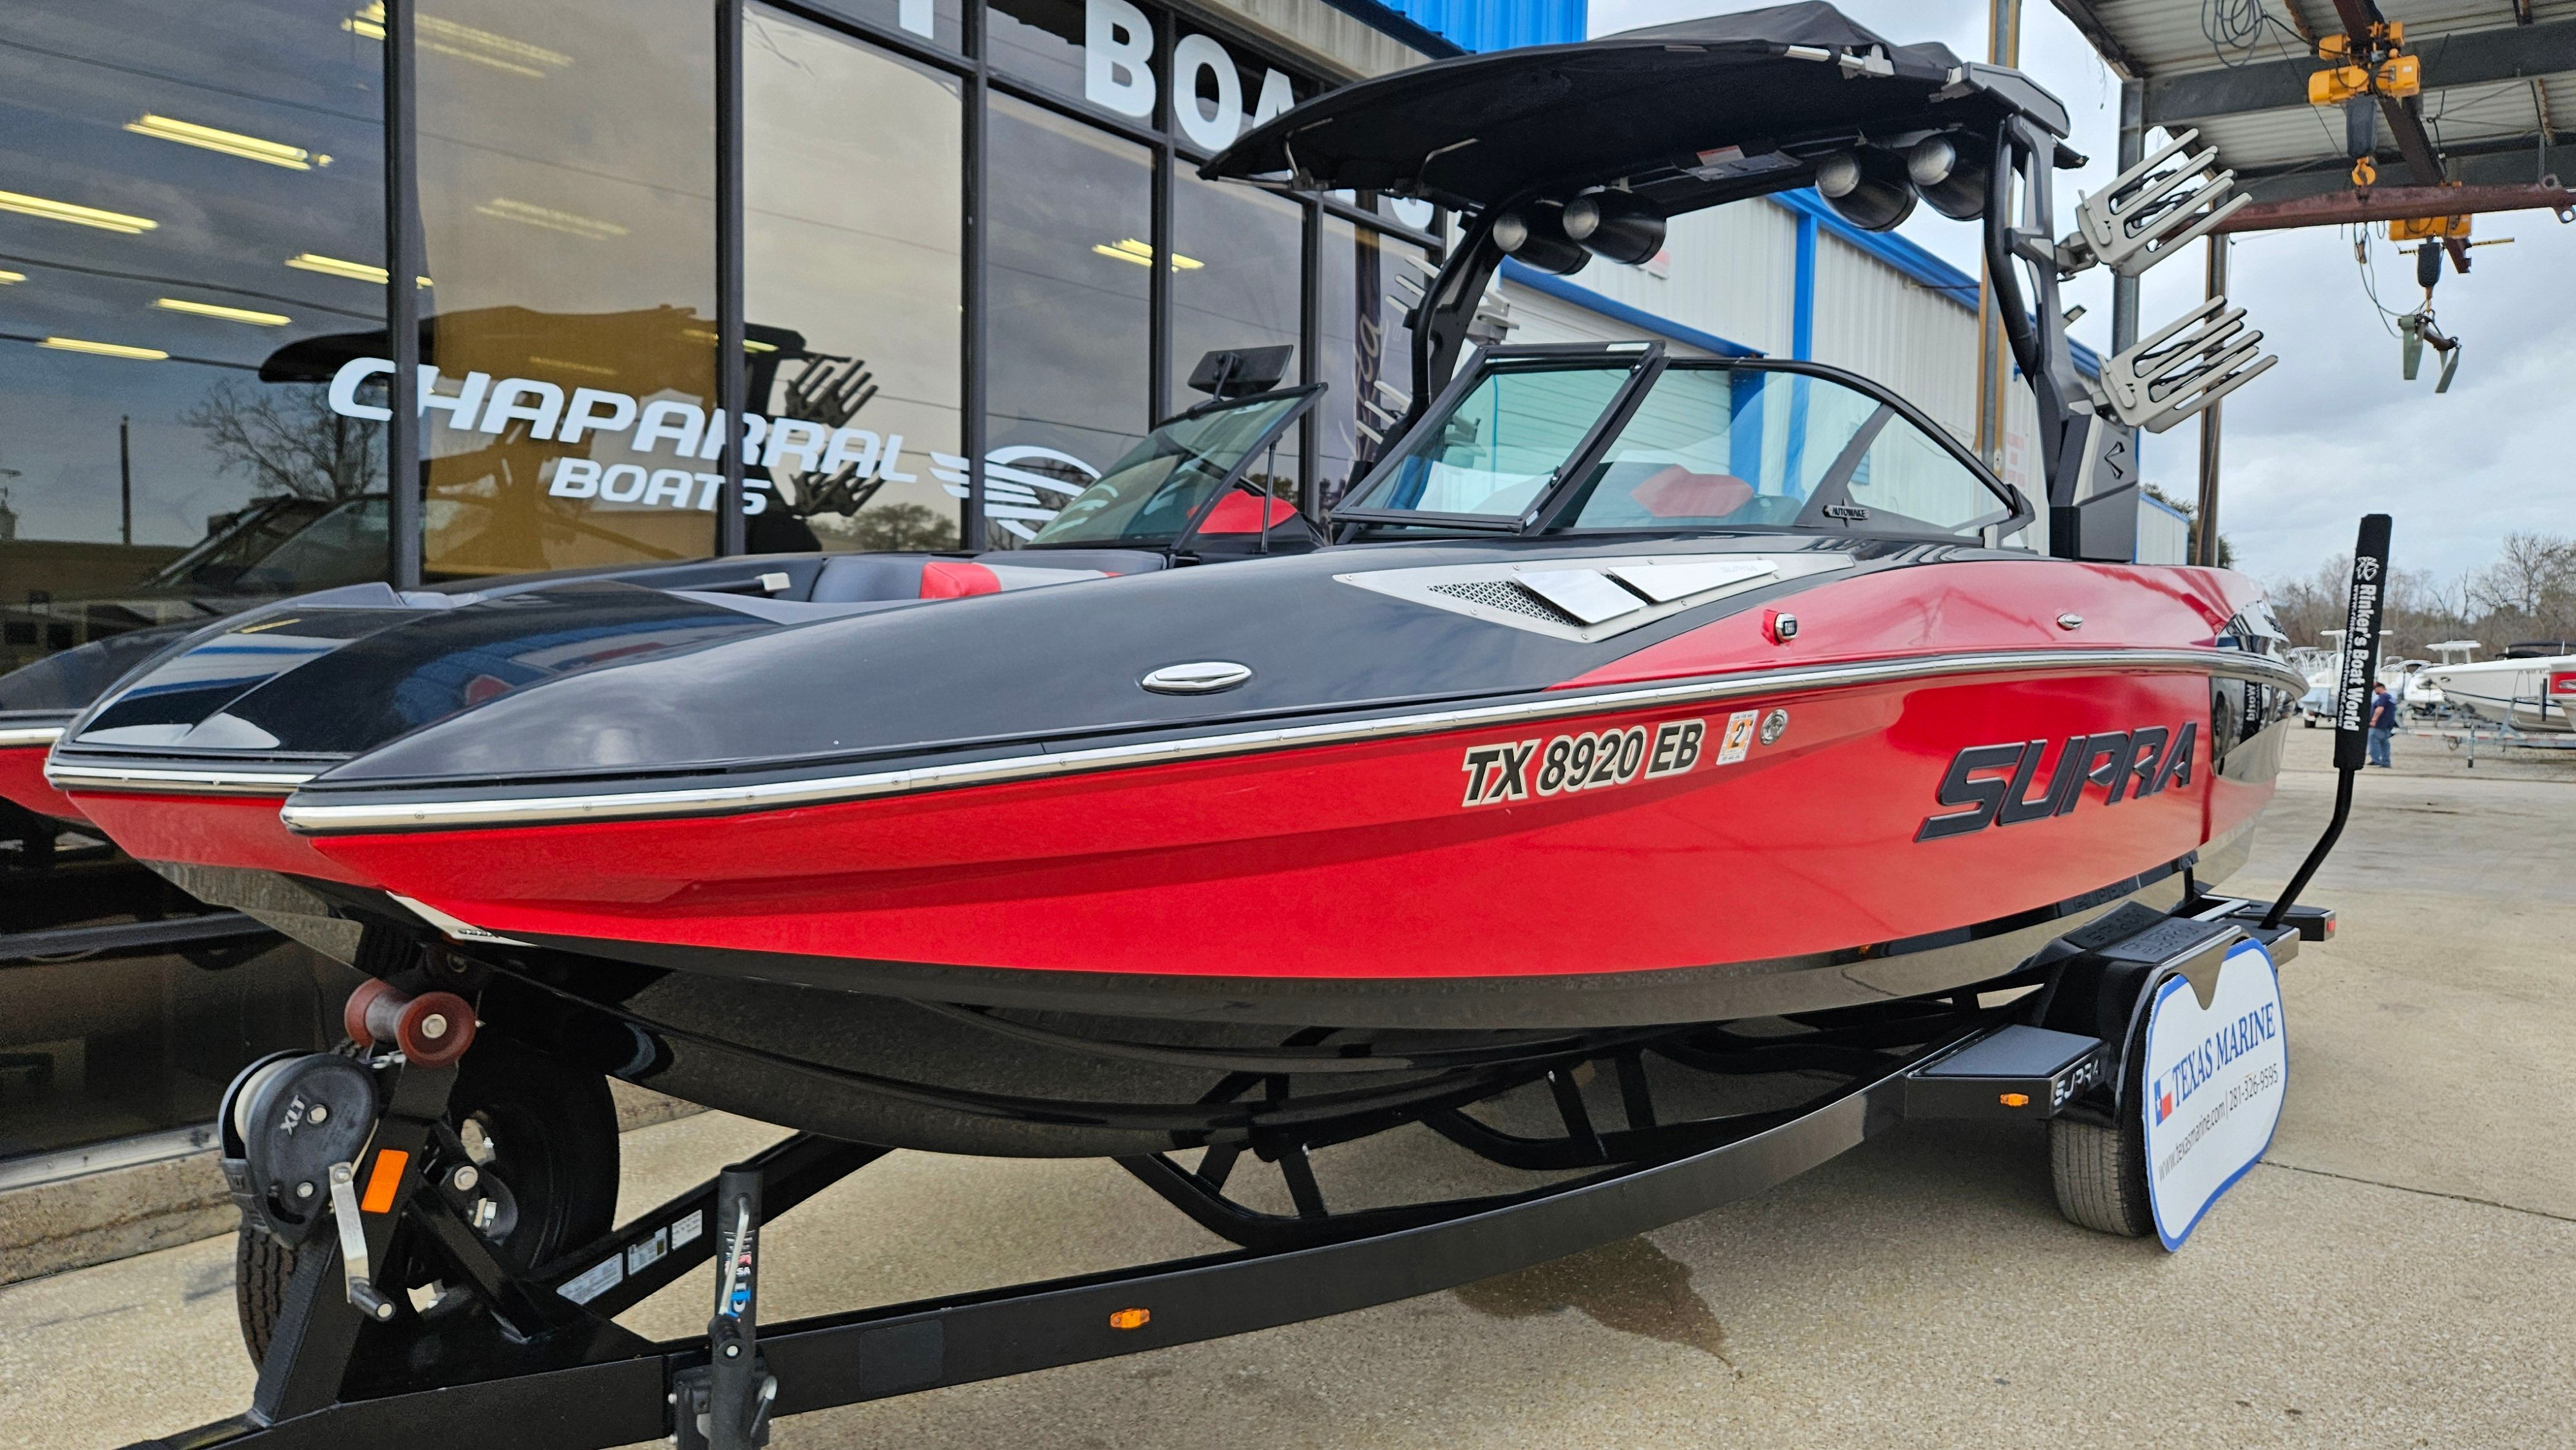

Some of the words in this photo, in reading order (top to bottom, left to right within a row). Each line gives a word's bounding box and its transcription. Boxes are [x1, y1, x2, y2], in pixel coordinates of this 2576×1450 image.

[328, 357, 917, 483] CHAPARRAL
[549, 457, 772, 514] BOATS
[2356, 583, 2376, 646] Rinker's
[2352, 649, 2369, 685] Boat
[2343, 687, 2364, 731] World
[1464, 742, 1537, 804] TX
[1539, 730, 1643, 791] 8920
[1648, 722, 1703, 775] EB
[1913, 721, 2197, 842] SUPRA
[2054, 1059, 2099, 1106] SUPRA
[2172, 1037, 2213, 1107] TEXAS
[2216, 1002, 2275, 1071] MARINE
[280, 1093, 311, 1135] XLT
[2158, 1102, 2225, 1181] www.texasmarine.com
[2230, 1063, 2278, 1111] 281-326-9595
